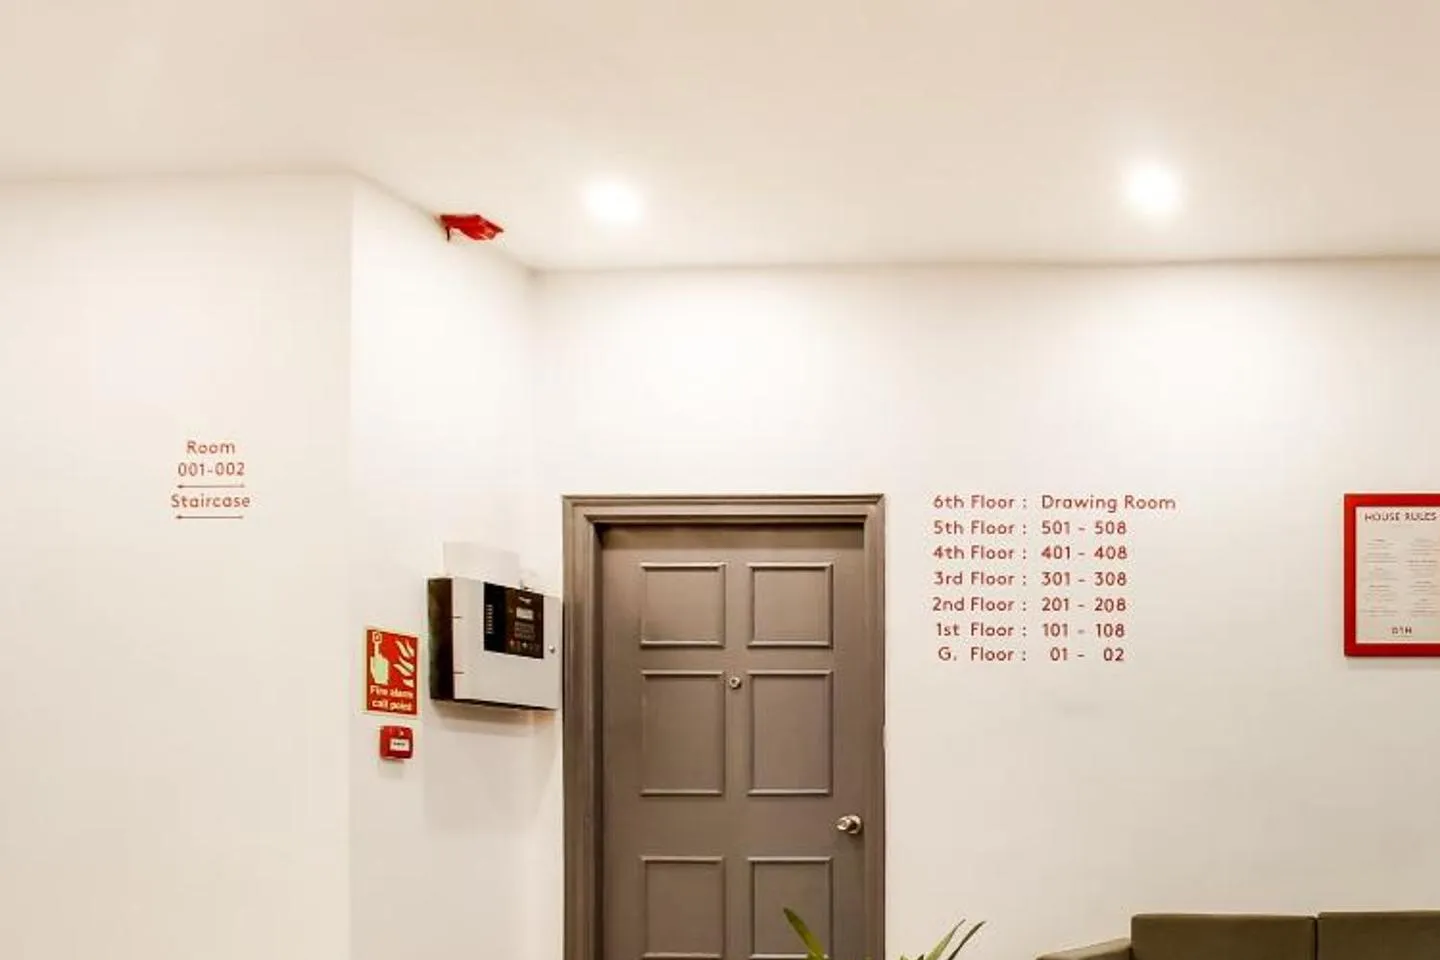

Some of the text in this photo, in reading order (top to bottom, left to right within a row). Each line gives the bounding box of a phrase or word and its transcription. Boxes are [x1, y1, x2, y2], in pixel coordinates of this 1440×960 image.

[186, 440, 236, 454] Room
[177, 462, 245, 477] 001-002
[170, 492, 251, 508] Staircase
[933, 494, 964, 509] 6th
[971, 494, 1015, 509] Floor
[1042, 494, 1117, 513] Drawing
[1124, 495, 1176, 509] Room
[1364, 511, 1437, 521] HOUSE RULES
[933, 520, 964, 535] 5th
[971, 520, 1015, 535] Floor
[1041, 520, 1070, 535] 501
[1094, 520, 1127, 535] 508
[933, 545, 965, 560] 4th
[971, 545, 1015, 560] Floor
[1041, 545, 1071, 560] 401
[1094, 545, 1128, 560] 408
[933, 571, 963, 586] 3rd
[971, 571, 1015, 586] Floor
[1041, 571, 1070, 586] 301
[1094, 571, 1127, 587] 308
[932, 596, 964, 612] 2nd
[971, 596, 1015, 612] Floor
[1042, 596, 1070, 612] 201
[1094, 596, 1127, 613] 208
[936, 622, 960, 637] 1st
[971, 622, 1015, 637] Floor
[1042, 622, 1069, 638] 101
[1095, 622, 1125, 638] 108
[938, 646, 957, 662] G.
[971, 646, 1015, 662] Floor
[1050, 646, 1069, 662] 01
[1103, 647, 1125, 662] 02
[370, 685, 389, 696] Fire
[372, 699, 389, 709] call
